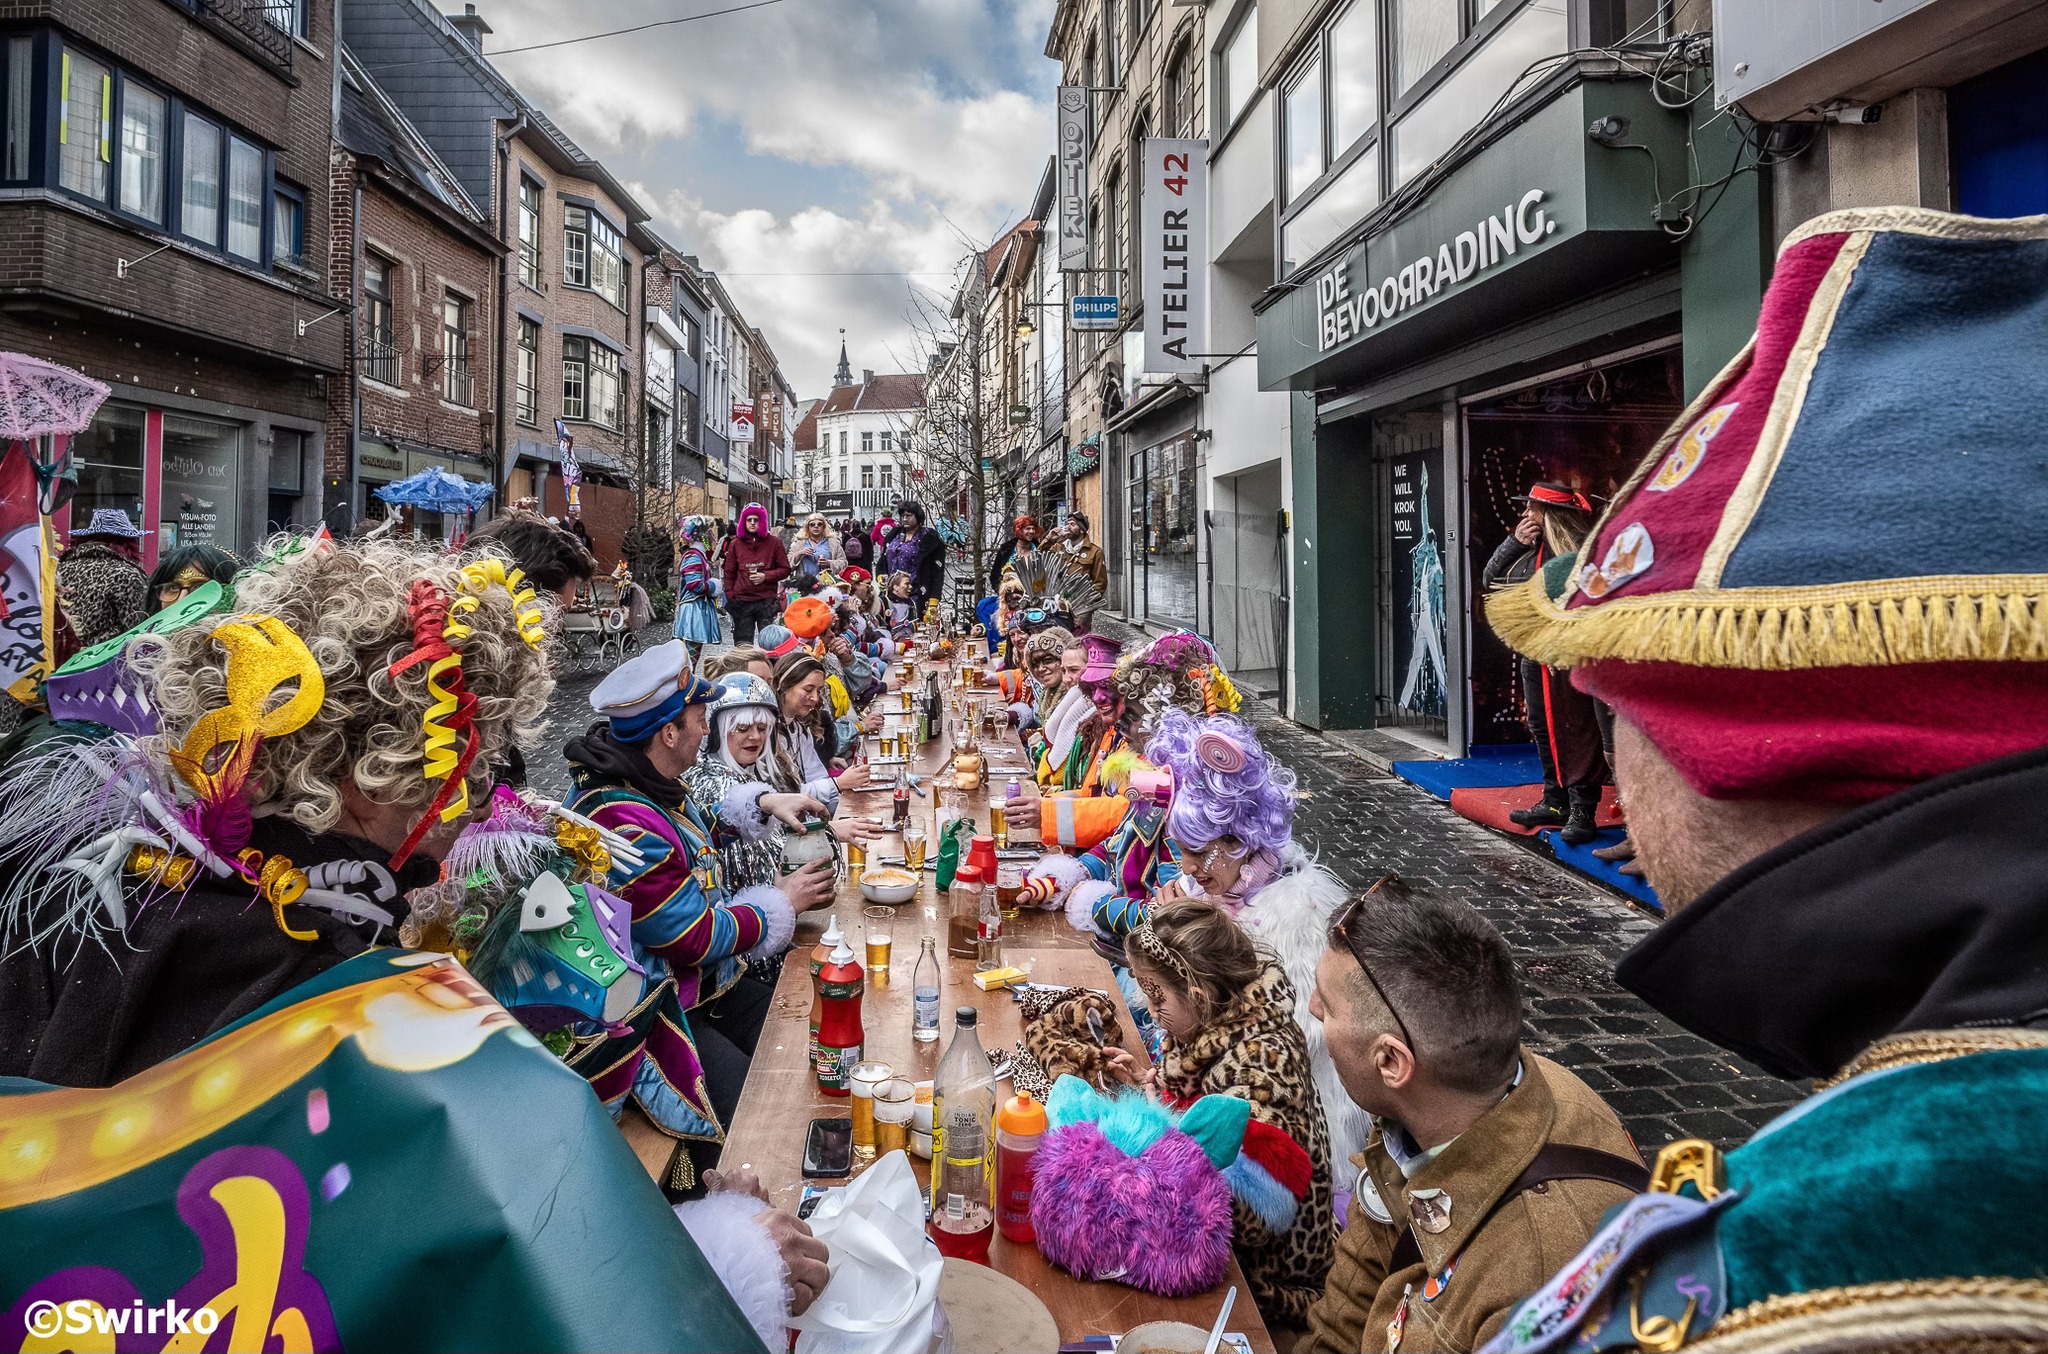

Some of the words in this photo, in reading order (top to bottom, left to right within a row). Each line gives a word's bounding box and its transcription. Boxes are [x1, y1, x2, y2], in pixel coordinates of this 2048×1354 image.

[1062, 121, 1085, 238] OPTIEK
[1163, 152, 1189, 197] 42
[1162, 207, 1188, 362] ATELIER
[1321, 262, 1348, 310] DE
[1074, 303, 1117, 313] PHILIPS
[361, 453, 403, 472] CHOCOLATIER
[1394, 464, 1407, 478] WE
[1394, 482, 1413, 496] WILL
[1394, 500, 1416, 514] KROK
[180, 512, 217, 522] VISUM-FOTO
[194, 523, 216, 531] LANDEN
[1394, 519, 1412, 532] YOU.
